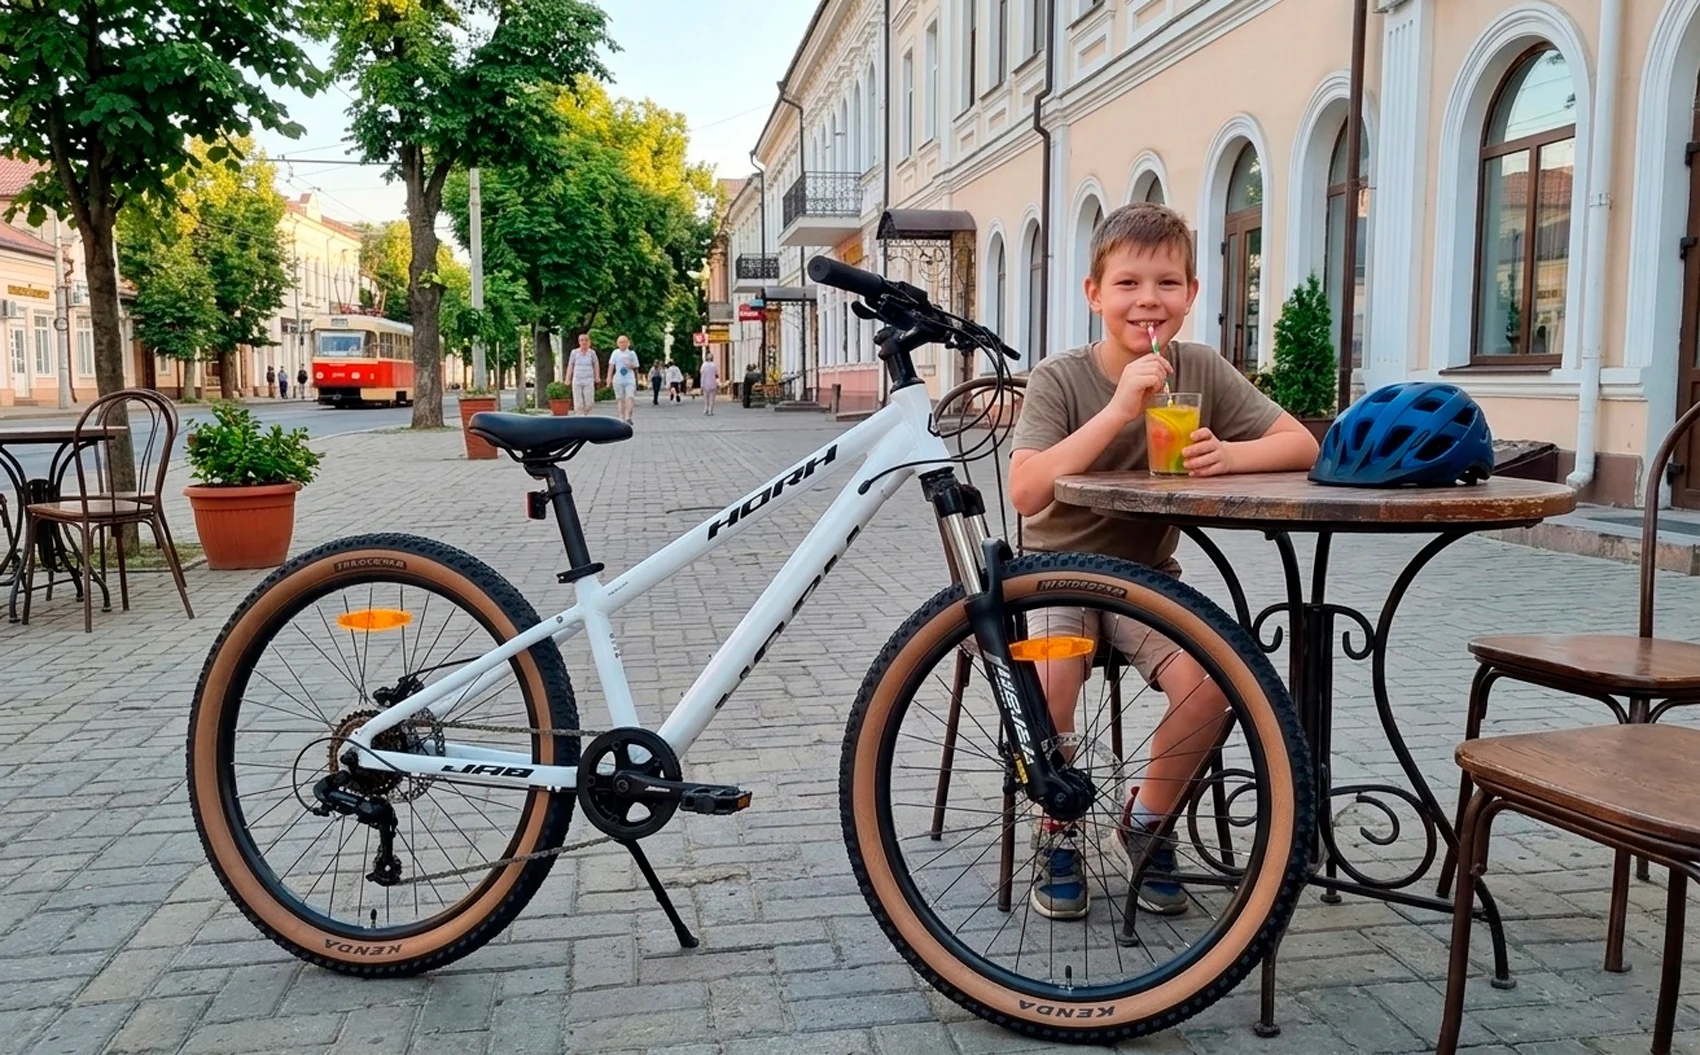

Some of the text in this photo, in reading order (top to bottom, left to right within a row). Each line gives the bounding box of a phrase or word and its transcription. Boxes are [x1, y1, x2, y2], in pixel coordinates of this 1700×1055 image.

[707, 444, 838, 541] HORH
[325, 939, 402, 956] KENDA
[1018, 999, 1116, 1018] KENDA
